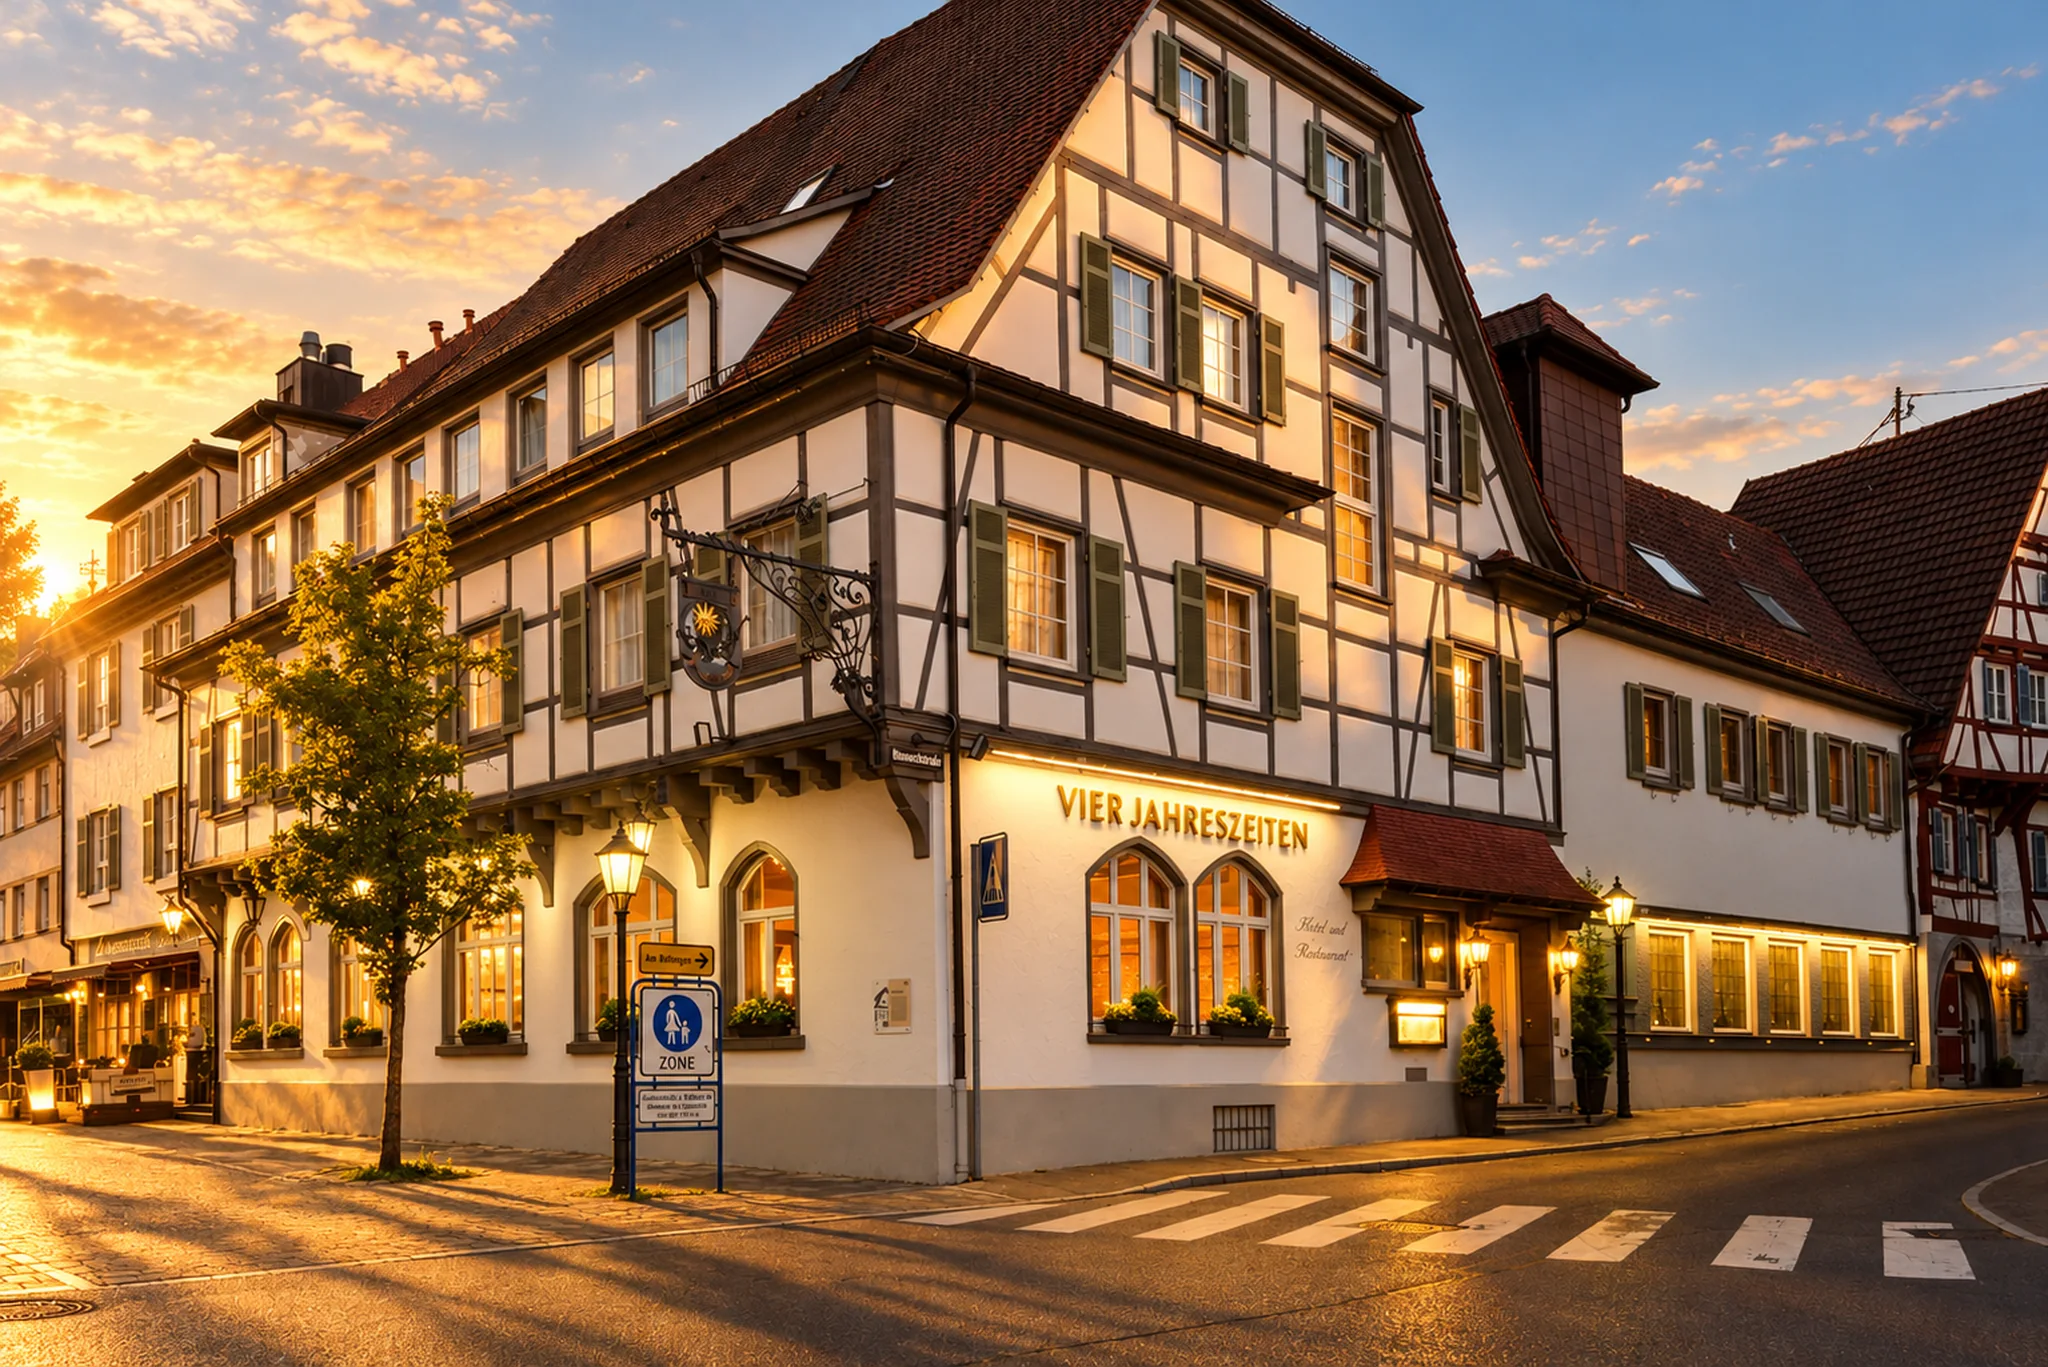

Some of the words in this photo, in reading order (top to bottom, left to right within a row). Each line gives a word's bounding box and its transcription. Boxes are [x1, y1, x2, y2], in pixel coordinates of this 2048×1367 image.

[1057, 785, 1122, 824] VIER
[1130, 797, 1309, 849] JAHRESZEITEN
[659, 1056, 695, 1070] ZONE
